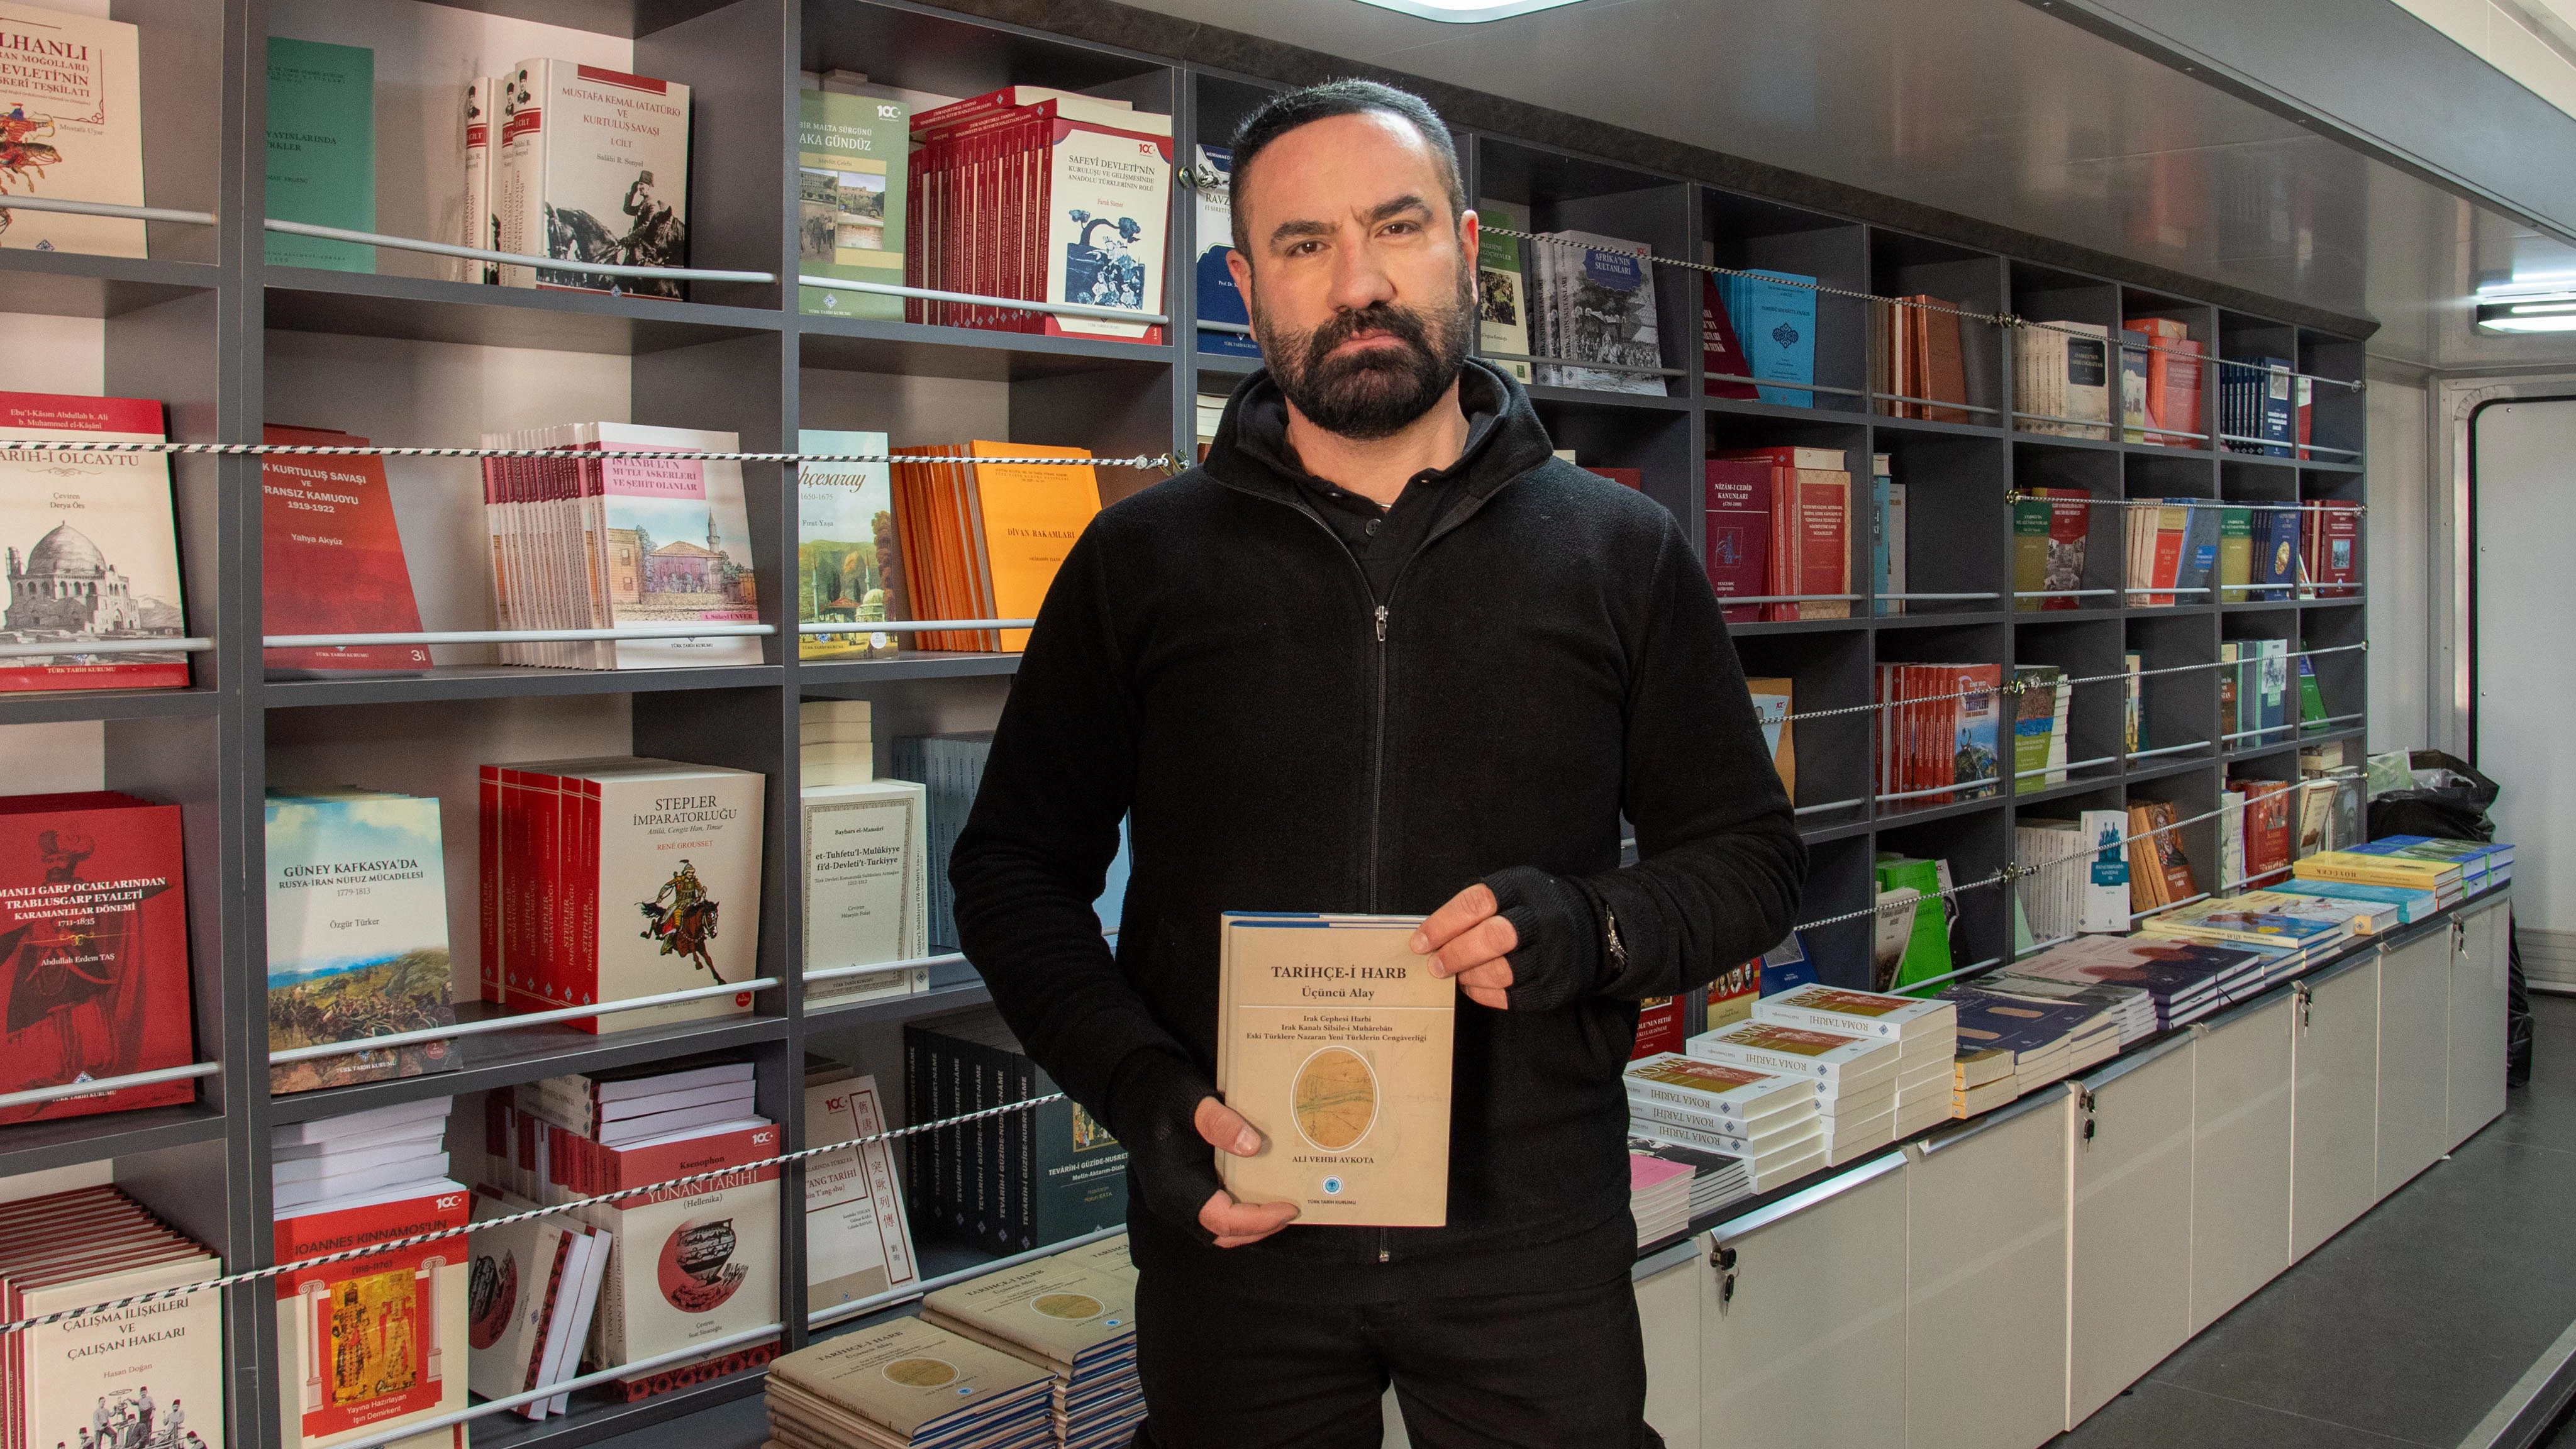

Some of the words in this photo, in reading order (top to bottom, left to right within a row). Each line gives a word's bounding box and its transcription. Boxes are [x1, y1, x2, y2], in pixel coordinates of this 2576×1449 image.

[22, 55, 89, 74] MOĞOLLARI)
[31, 82, 90, 97] TEŞKİLATI
[562, 87, 603, 103] MUSTAFA
[606, 94, 635, 108] KEMAL
[636, 99, 680, 117] (ATATÜRK)
[617, 109, 628, 119] VE
[584, 114, 630, 132] KURTULUŞ
[631, 121, 660, 137] SAVAŞI
[813, 123, 836, 133] MALTA
[838, 126, 872, 136] SÜRGÜNÜ
[799, 133, 822, 146] AKA
[825, 135, 872, 151] GÜNDÜZ
[1069, 155, 1099, 167] SAFEVÎ
[1101, 159, 1155, 175] DEVLETİ'NİN
[1069, 165, 1101, 177] KURULUŞU
[1111, 172, 1155, 184] GELİŞMESİNDE
[1068, 174, 1097, 184] ANADOLU
[1099, 178, 1138, 190] TÜRKLERİNİN
[1139, 184, 1153, 192] ROLÜ
[1594, 252, 1631, 267] AFRİKA'NIN
[1595, 262, 1631, 275] SULTANLARI
[57, 411, 87, 419] Abdullah
[27, 419, 69, 428] Muhammed
[59, 451, 140, 467] OLCAYTU
[272, 463, 328, 482] KURTULUŞ
[330, 472, 366, 486] SAVAŞI
[613, 468, 643, 477] MUTLU
[646, 470, 697, 480] ASKERLERİ
[301, 479, 312, 488] VE
[613, 479, 624, 487] VE
[626, 479, 655, 489] ŞEHİT
[656, 481, 697, 491] OLANLAR
[53, 492, 80, 502] Çeviren
[306, 491, 358, 505] KAMUOYU
[801, 492, 834, 501] 1650-1675
[1718, 492, 1748, 500] KANUNLARI
[50, 501, 70, 511] Derya
[72, 501, 85, 509] Örs
[287, 501, 335, 513] 1919-1922
[291, 533, 316, 545] Yahya
[318, 536, 343, 546] Akyüz
[1008, 526, 1030, 537] DİVAN
[1033, 529, 1075, 540] RAKAMLARI
[655, 795, 718, 811] STEPLER
[633, 808, 737, 826] İMPARATORLUĞU
[668, 826, 689, 835] Cengiz
[835, 828, 855, 836] Baybars
[677, 840, 714, 850] GROUSSET
[816, 844, 900, 861] et-Tuhfetu'l-Mulûkiyye
[284, 864, 331, 878] GÜNEY
[335, 859, 418, 874] KAFKASYA'DA
[817, 856, 898, 872] fi'd-Devleti't-Turkiyye
[39, 884, 71, 894] GARP
[74, 877, 166, 892] OCAKLARINDAN
[279, 878, 334, 889] RUSYA-İRAN
[336, 874, 367, 885] NÜFUZ
[369, 870, 424, 883] MÜCADELESİ
[5, 895, 92, 909] TRABLUSGARP
[95, 889, 143, 902] EYALETİ
[337, 887, 371, 897] 1779-1813
[14, 908, 94, 921] KARAMANLILAR
[96, 901, 136, 914] DÖNEMİ
[57, 917, 95, 928] 1711-1835
[330, 919, 353, 930] Özgür
[355, 918, 379, 928] Türker
[41, 957, 73, 967] Abdullah
[75, 955, 99, 964] Erdem
[99, 953, 115, 963] TAŞ
[1271, 963, 1355, 982] TARİHÇE-İ
[1362, 967, 1407, 980] HARB
[1302, 987, 1346, 999] Üçüncü
[1349, 987, 1375, 1000] Alay
[1320, 1014, 1349, 1024] Cephesi
[1809, 1015, 1840, 1028] TARİHİ
[1841, 1020, 1869, 1032] ROMA
[1352, 1024, 1392, 1033] Muhârebâtı
[1263, 1033, 1296, 1041] Türklere
[1345, 1034, 1380, 1042] Türklerin
[1382, 1035, 1427, 1044] Cengâverliği
[1745, 1053, 1777, 1067] TARİHİ
[1779, 1058, 1807, 1072] ROMA
[1650, 1089, 1680, 1103] TARİHİ
[1683, 1096, 1710, 1109] ROMA
[1653, 1108, 1684, 1121] TARİHİ
[1686, 1114, 1714, 1128] ROMA
[1659, 1126, 1690, 1140] TARİHİ
[1692, 1132, 1721, 1146] ROMA
[680, 1155, 725, 1170] Ksenophon
[1292, 1155, 1307, 1163] ALİ
[1309, 1155, 1338, 1163] VEHBİ
[827, 1169, 857, 1183] TARİHİ
[648, 1181, 702, 1204] YUNAN
[683, 1193, 723, 1210] (Hellenika)
[294, 1236, 353, 1256] IOANNES
[357, 1219, 447, 1245] KINNAMOS'UN
[63, 1311, 121, 1333] ÇALIŞMA
[125, 1296, 189, 1319] İLİŞKİLERİ
[119, 1323, 136, 1334] VE
[67, 1338, 125, 1360] ÇALIŞAN
[129, 1327, 186, 1347] HAKLARI
[103, 1368, 127, 1379] Hasan
[128, 1363, 153, 1375] Doğan
[347, 1404, 370, 1416] Yayına
[371, 1393, 407, 1410] Hazırlayan
[353, 1414, 367, 1424] Işın
[367, 1404, 401, 1421] Demirkent
